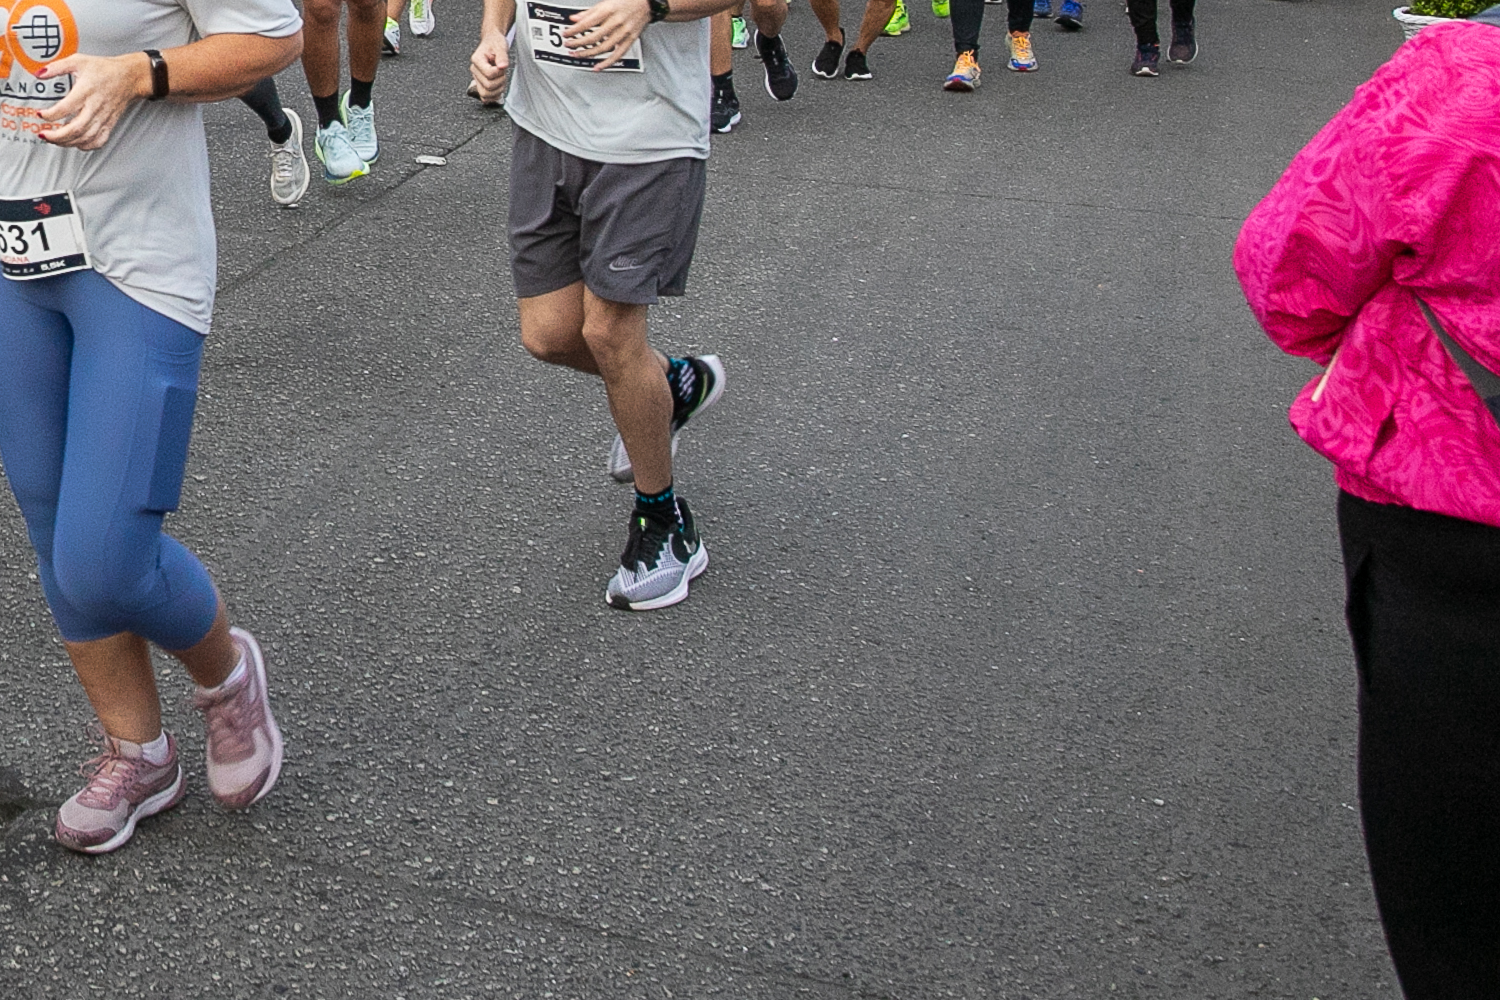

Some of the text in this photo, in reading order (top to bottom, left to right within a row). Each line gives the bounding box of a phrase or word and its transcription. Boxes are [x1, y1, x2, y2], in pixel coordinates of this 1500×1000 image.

[4, 82, 66, 93] ANOS
[1, 102, 39, 118] CORR
[1, 117, 64, 134] DO PORT
